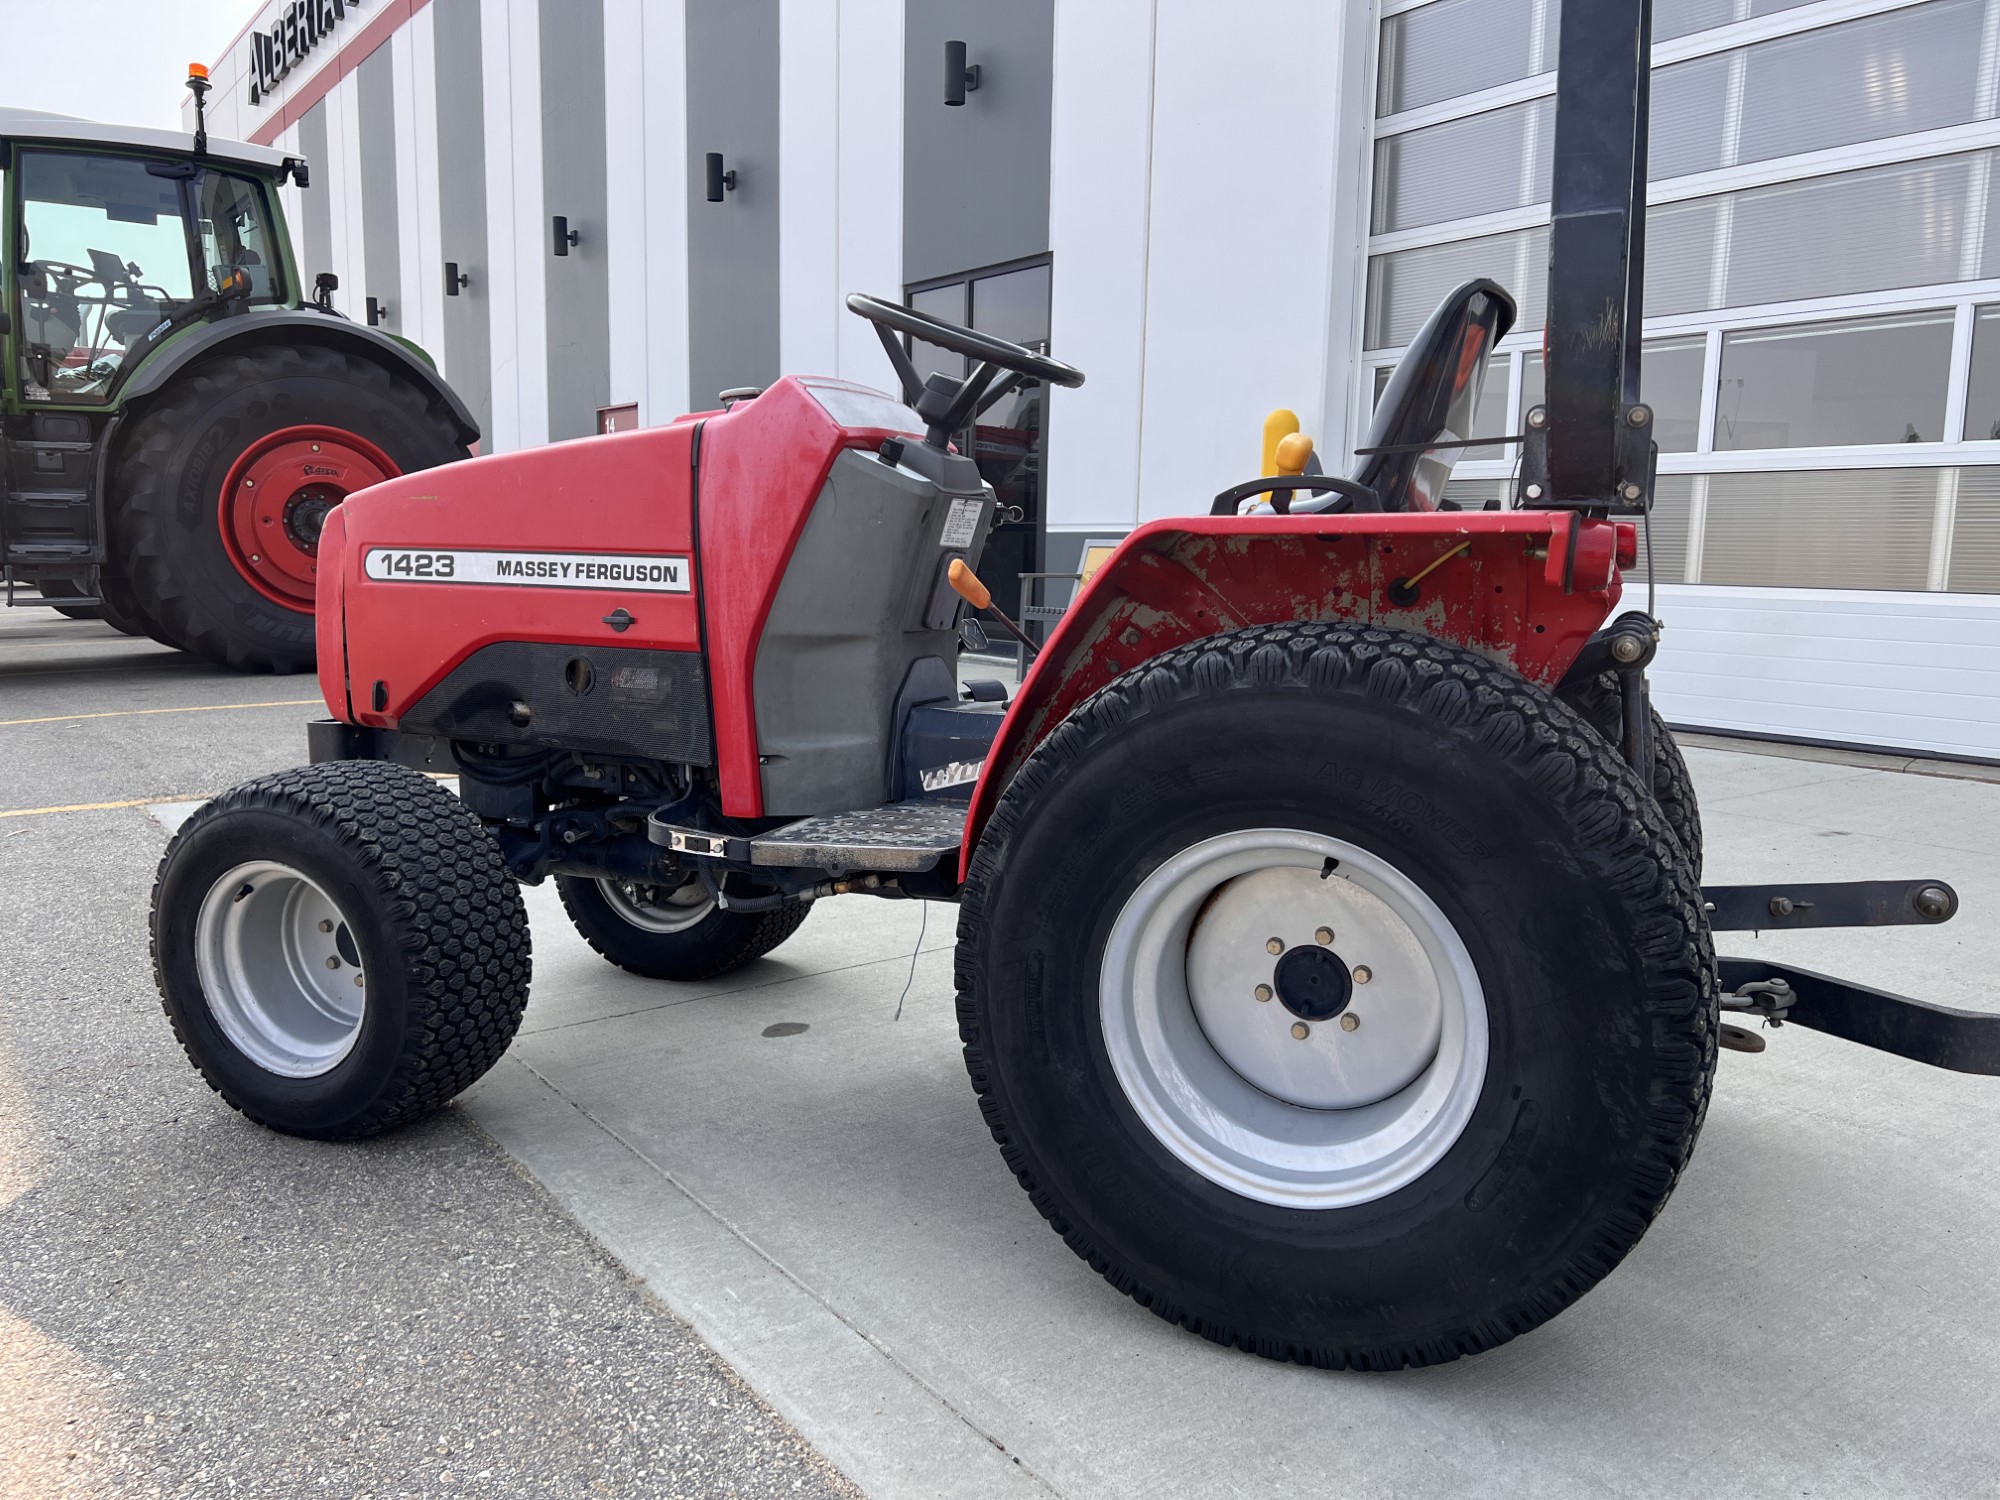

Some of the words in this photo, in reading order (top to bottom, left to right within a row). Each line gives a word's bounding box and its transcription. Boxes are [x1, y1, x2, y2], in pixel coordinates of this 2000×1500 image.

[605, 417, 616, 434] 14
[381, 553, 455, 577] 1423
[497, 559, 572, 579] MASSEY
[575, 562, 679, 583] FERGUSON
[1314, 761, 1363, 789] AG
[1371, 777, 1490, 862] MOWER
